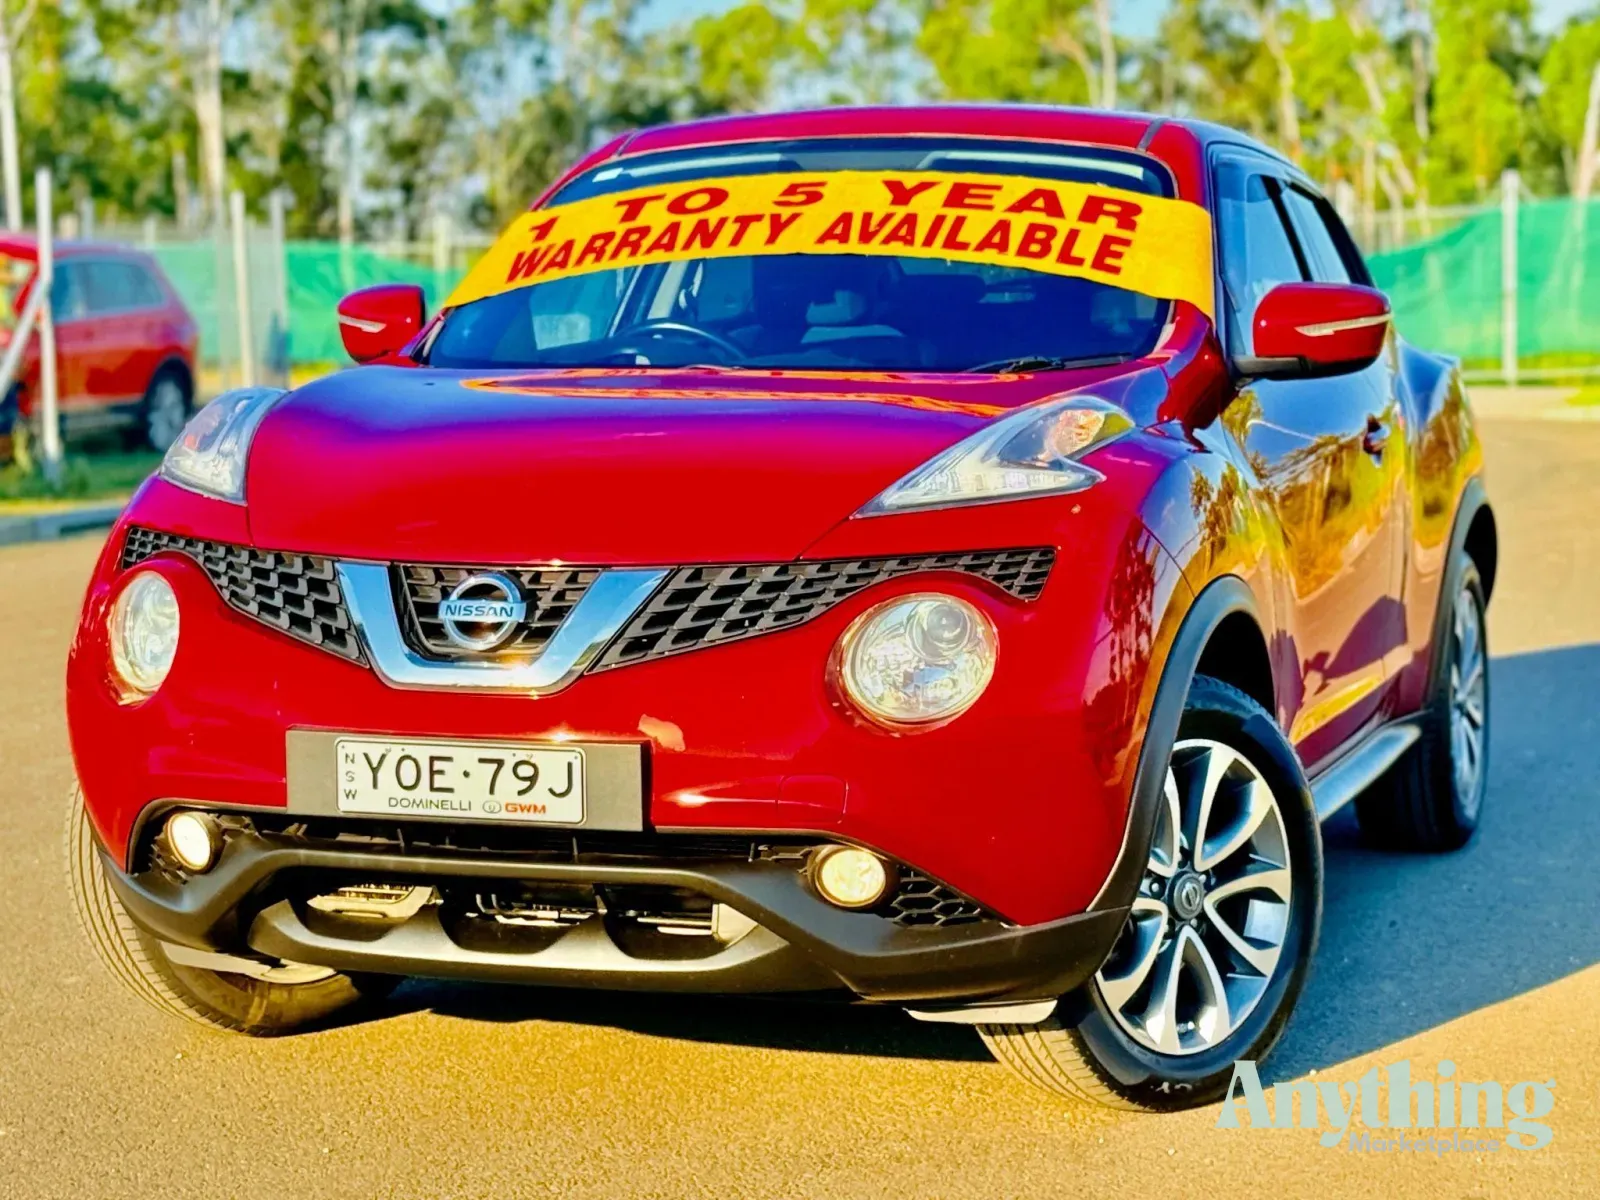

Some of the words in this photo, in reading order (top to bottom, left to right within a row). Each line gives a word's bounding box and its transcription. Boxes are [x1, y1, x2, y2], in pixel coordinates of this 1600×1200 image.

[529, 216, 561, 243] 1
[614, 187, 730, 224] TO
[772, 181, 828, 208] 5
[881, 179, 1144, 233] YEAR
[505, 212, 803, 284] WARRANTY
[814, 211, 1133, 276] AVAILABLE
[445, 604, 514, 618] NISSAN
[388, 796, 472, 812] DOMINELLI
[504, 802, 546, 814] GWM
